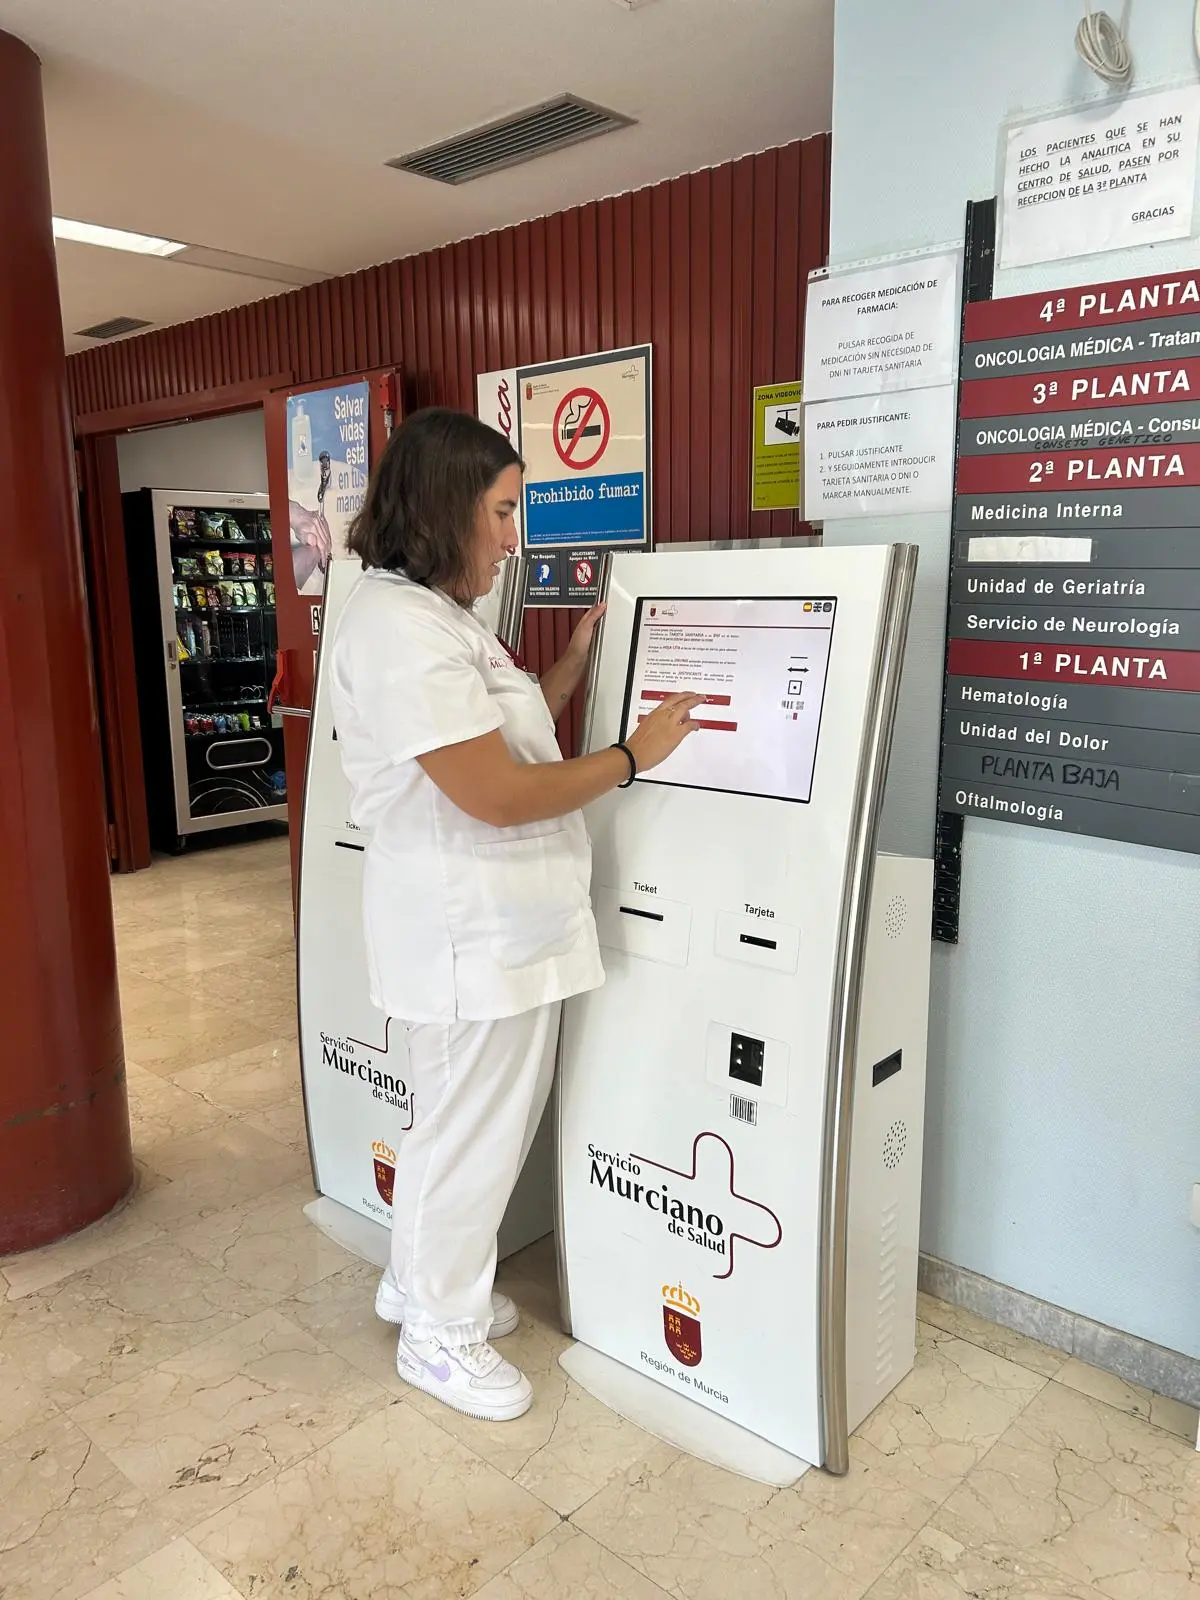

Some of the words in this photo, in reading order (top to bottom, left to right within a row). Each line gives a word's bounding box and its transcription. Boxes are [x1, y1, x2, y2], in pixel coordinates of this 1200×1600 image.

[1020, 147, 1037, 160] LOS
[1046, 134, 1096, 153] PACIENTES
[1105, 127, 1127, 140] QUE
[1136, 122, 1149, 133] SE
[1159, 115, 1182, 128] HAN
[1018, 161, 1050, 175] HECHO
[1060, 156, 1071, 167] LA
[1081, 142, 1131, 161] ANALITICA
[1142, 137, 1156, 148] EN
[1167, 132, 1181, 143] SU
[1017, 176, 1053, 191] CENTRO
[1059, 172, 1072, 183] DE
[1078, 164, 1112, 179] SALUD,
[1119, 155, 1151, 170] PASEN
[1158, 150, 1179, 162] POR
[1017, 189, 1066, 207] RECEPCION
[1068, 186, 1080, 196] DE
[1082, 183, 1094, 194] LA
[1096, 181, 1107, 191] 3ª
[1109, 173, 1148, 189] PLANTA
[1131, 206, 1175, 222] GRACIAS
[821, 297, 841, 308] PARA
[841, 291, 876, 304] RECOGER
[878, 281, 925, 298] MEDICACIÓN
[927, 279, 938, 288] DE
[1040, 298, 1065, 322] 4ª
[1079, 279, 1200, 317] PLANTA
[857, 302, 899, 315] FARMACIA:
[838, 339, 866, 350] PULSAR
[867, 334, 904, 346] RECOGIDA
[905, 331, 915, 341] DE
[975, 344, 1066, 368] ONCOLOGIA
[1070, 336, 1134, 358] MÉDICA
[821, 351, 866, 366] MEDICACIÓN
[868, 351, 880, 360] SIN
[881, 344, 921, 358] NECESIDAD
[922, 343, 933, 352] DE
[829, 369, 842, 379] DNI
[844, 367, 852, 376] NI
[853, 363, 884, 376] TARJETA
[884, 358, 922, 372] SANITARIA
[757, 391, 774, 401] ZONA
[1033, 381, 1058, 404] 3ª
[1071, 369, 1190, 401] PLANTA
[334, 394, 364, 420] Salvar
[339, 417, 364, 442] vidas
[816, 421, 836, 430] PARA
[836, 418, 858, 428] PEDIR
[859, 412, 911, 425] JUSTIFICANTE:
[976, 425, 1065, 445] ONCOLOGIA
[1070, 420, 1133, 438] MÉDICA
[346, 440, 365, 465] está
[828, 449, 854, 459] PULSAR
[855, 444, 903, 457] JUSTIFICANTE
[1098, 434, 1173, 446] GENETICO
[828, 463, 833, 472] Y
[833, 460, 889, 472] SEGUIDAMENTE
[890, 456, 936, 468] INTRODUCIR
[1029, 461, 1054, 483] 2ª
[1067, 454, 1185, 481] PLANTA
[338, 471, 350, 491] en
[351, 467, 365, 489] tus
[822, 475, 851, 487] TARJETA
[852, 473, 889, 485] SANITARIA
[891, 472, 898, 480] O
[898, 471, 911, 480] DNI
[912, 470, 919, 479] O
[530, 485, 594, 505] Prohibido
[598, 482, 640, 499] fumar
[822, 490, 851, 500] MARCAR
[853, 486, 912, 498] MANUALMENTE.
[971, 504, 1048, 520] Medicina
[1057, 503, 1123, 518] Interna
[967, 578, 1026, 594] Unidad
[1034, 579, 1054, 594] de
[1062, 579, 1146, 595] Geriatría
[967, 614, 1038, 631] Servicio
[1043, 616, 1066, 632] de
[1072, 617, 1180, 638] Neurología
[1019, 652, 1042, 671] 1ª
[1055, 653, 1168, 680] PLANTA
[961, 686, 1068, 711] Hematología
[960, 721, 1018, 741] Unidad
[1025, 728, 1051, 745] del
[1059, 732, 1109, 751] Dolor
[981, 755, 1054, 783] PLANTA
[1062, 763, 1120, 791] BAJA
[955, 790, 1064, 821] Oftalmología
[633, 881, 658, 894] Ticket
[744, 903, 775, 919] Tarjeta
[319, 1031, 355, 1054] Servicio
[322, 1044, 407, 1097] Murciano
[372, 1087, 383, 1100] de
[384, 1091, 409, 1111] Salud
[587, 1143, 641, 1176] Servicio
[589, 1159, 724, 1236] Murciano
[667, 1219, 685, 1237] de
[687, 1226, 726, 1256] Salud
[640, 1350, 675, 1378] Región
[677, 1370, 692, 1385] de
[693, 1378, 730, 1404] Murcia
